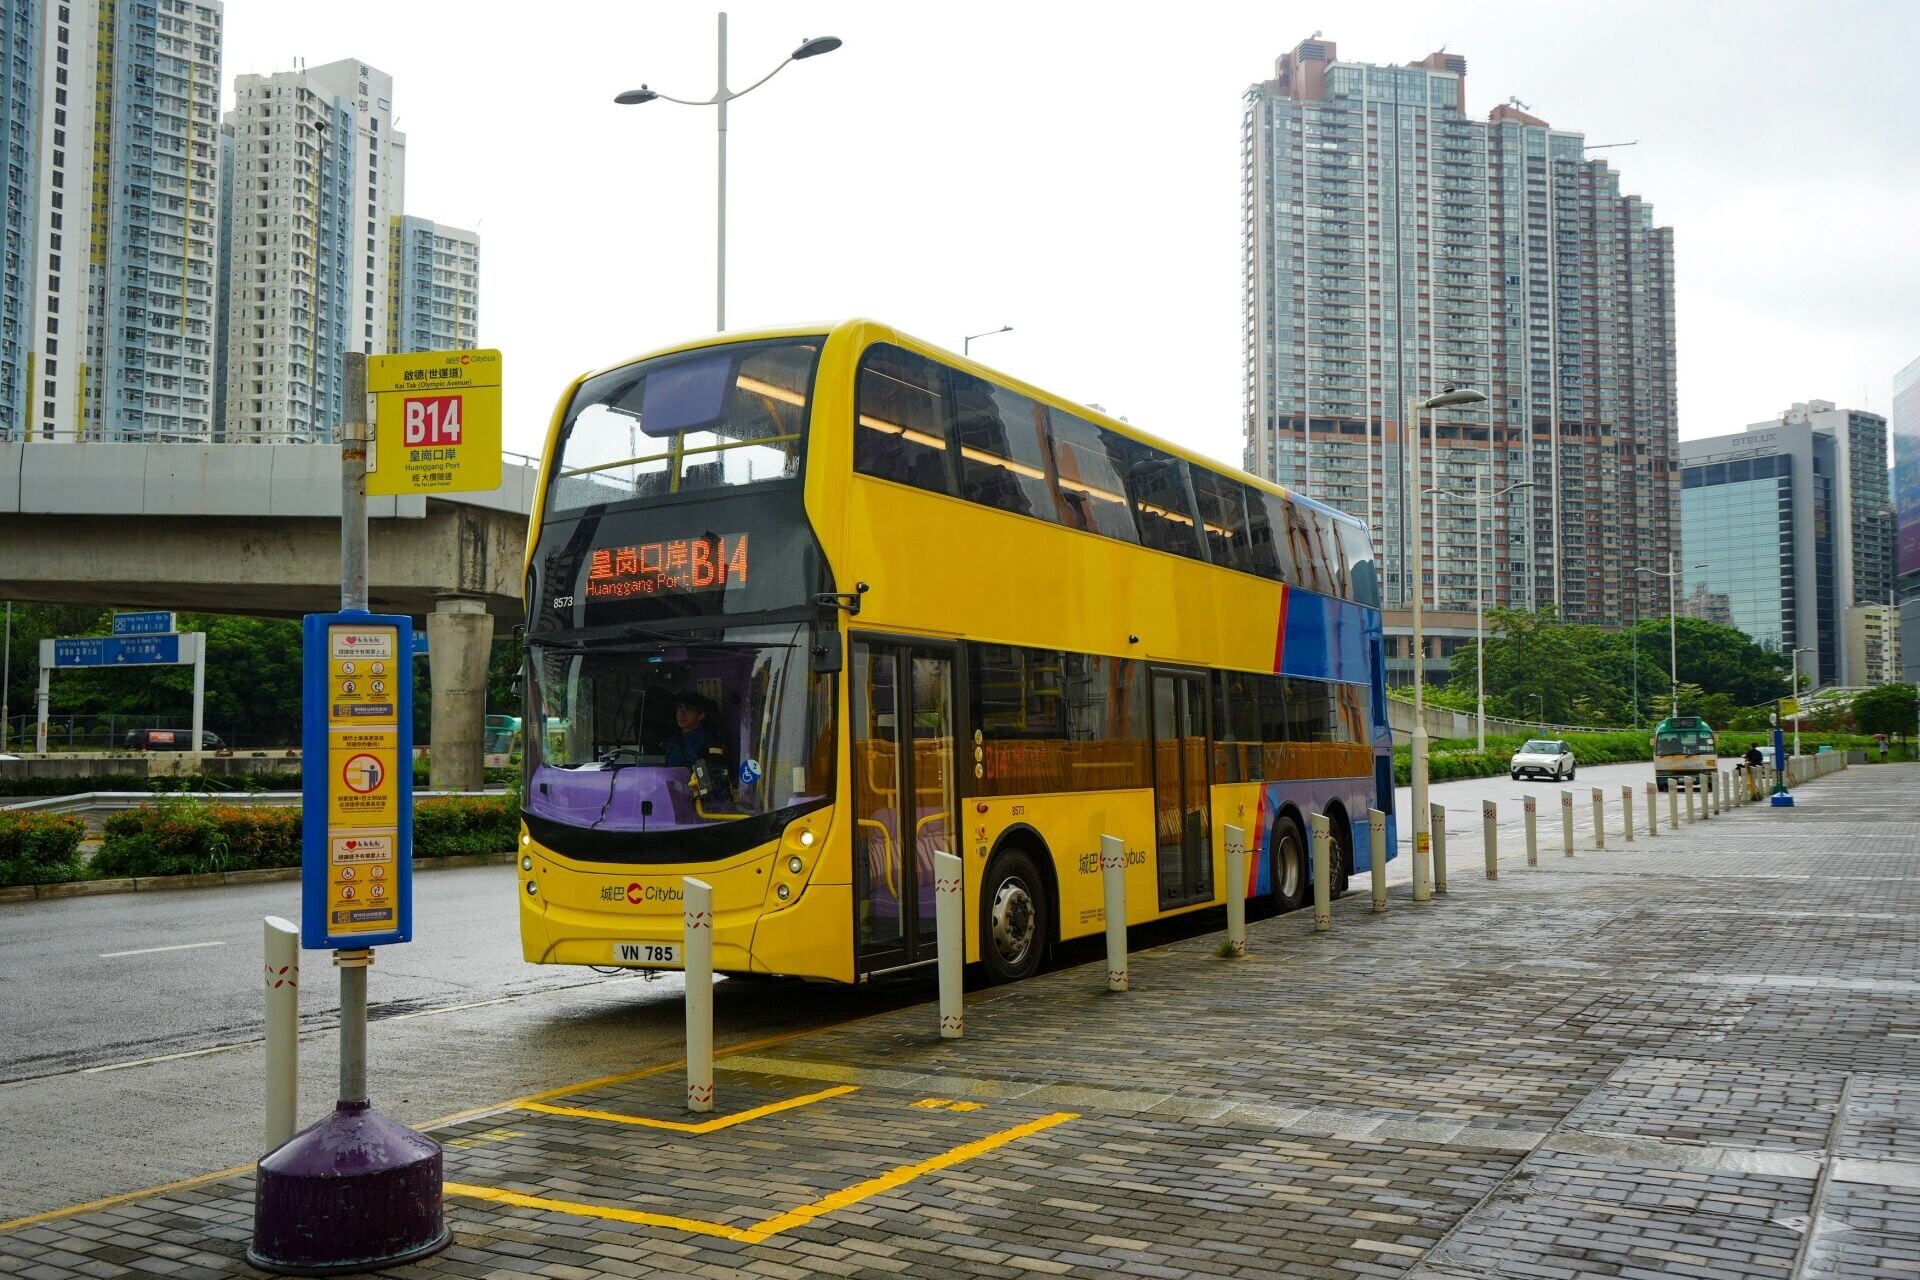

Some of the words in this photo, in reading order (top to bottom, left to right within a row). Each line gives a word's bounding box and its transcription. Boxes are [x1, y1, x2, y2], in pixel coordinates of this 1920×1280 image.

[471, 355, 496, 363] Citybus
[418, 380, 445, 388] (Olympic
[446, 379, 472, 387] Avenue)
[406, 399, 460, 444] B14
[409, 448, 456, 462] 皇崗口岸
[405, 463, 444, 471] Huanggang
[692, 535, 748, 587] B14
[585, 579, 654, 597] Huanggang
[657, 573, 690, 589] Port
[553, 596, 573, 609] 8573
[1011, 805, 1025, 816] 8573
[1079, 852, 1098, 875] 城巴
[1123, 847, 1146, 869] ybus
[600, 885, 625, 902] 城巴
[645, 885, 684, 902] Citybu
[621, 945, 639, 961] VN
[645, 946, 673, 961] 785
